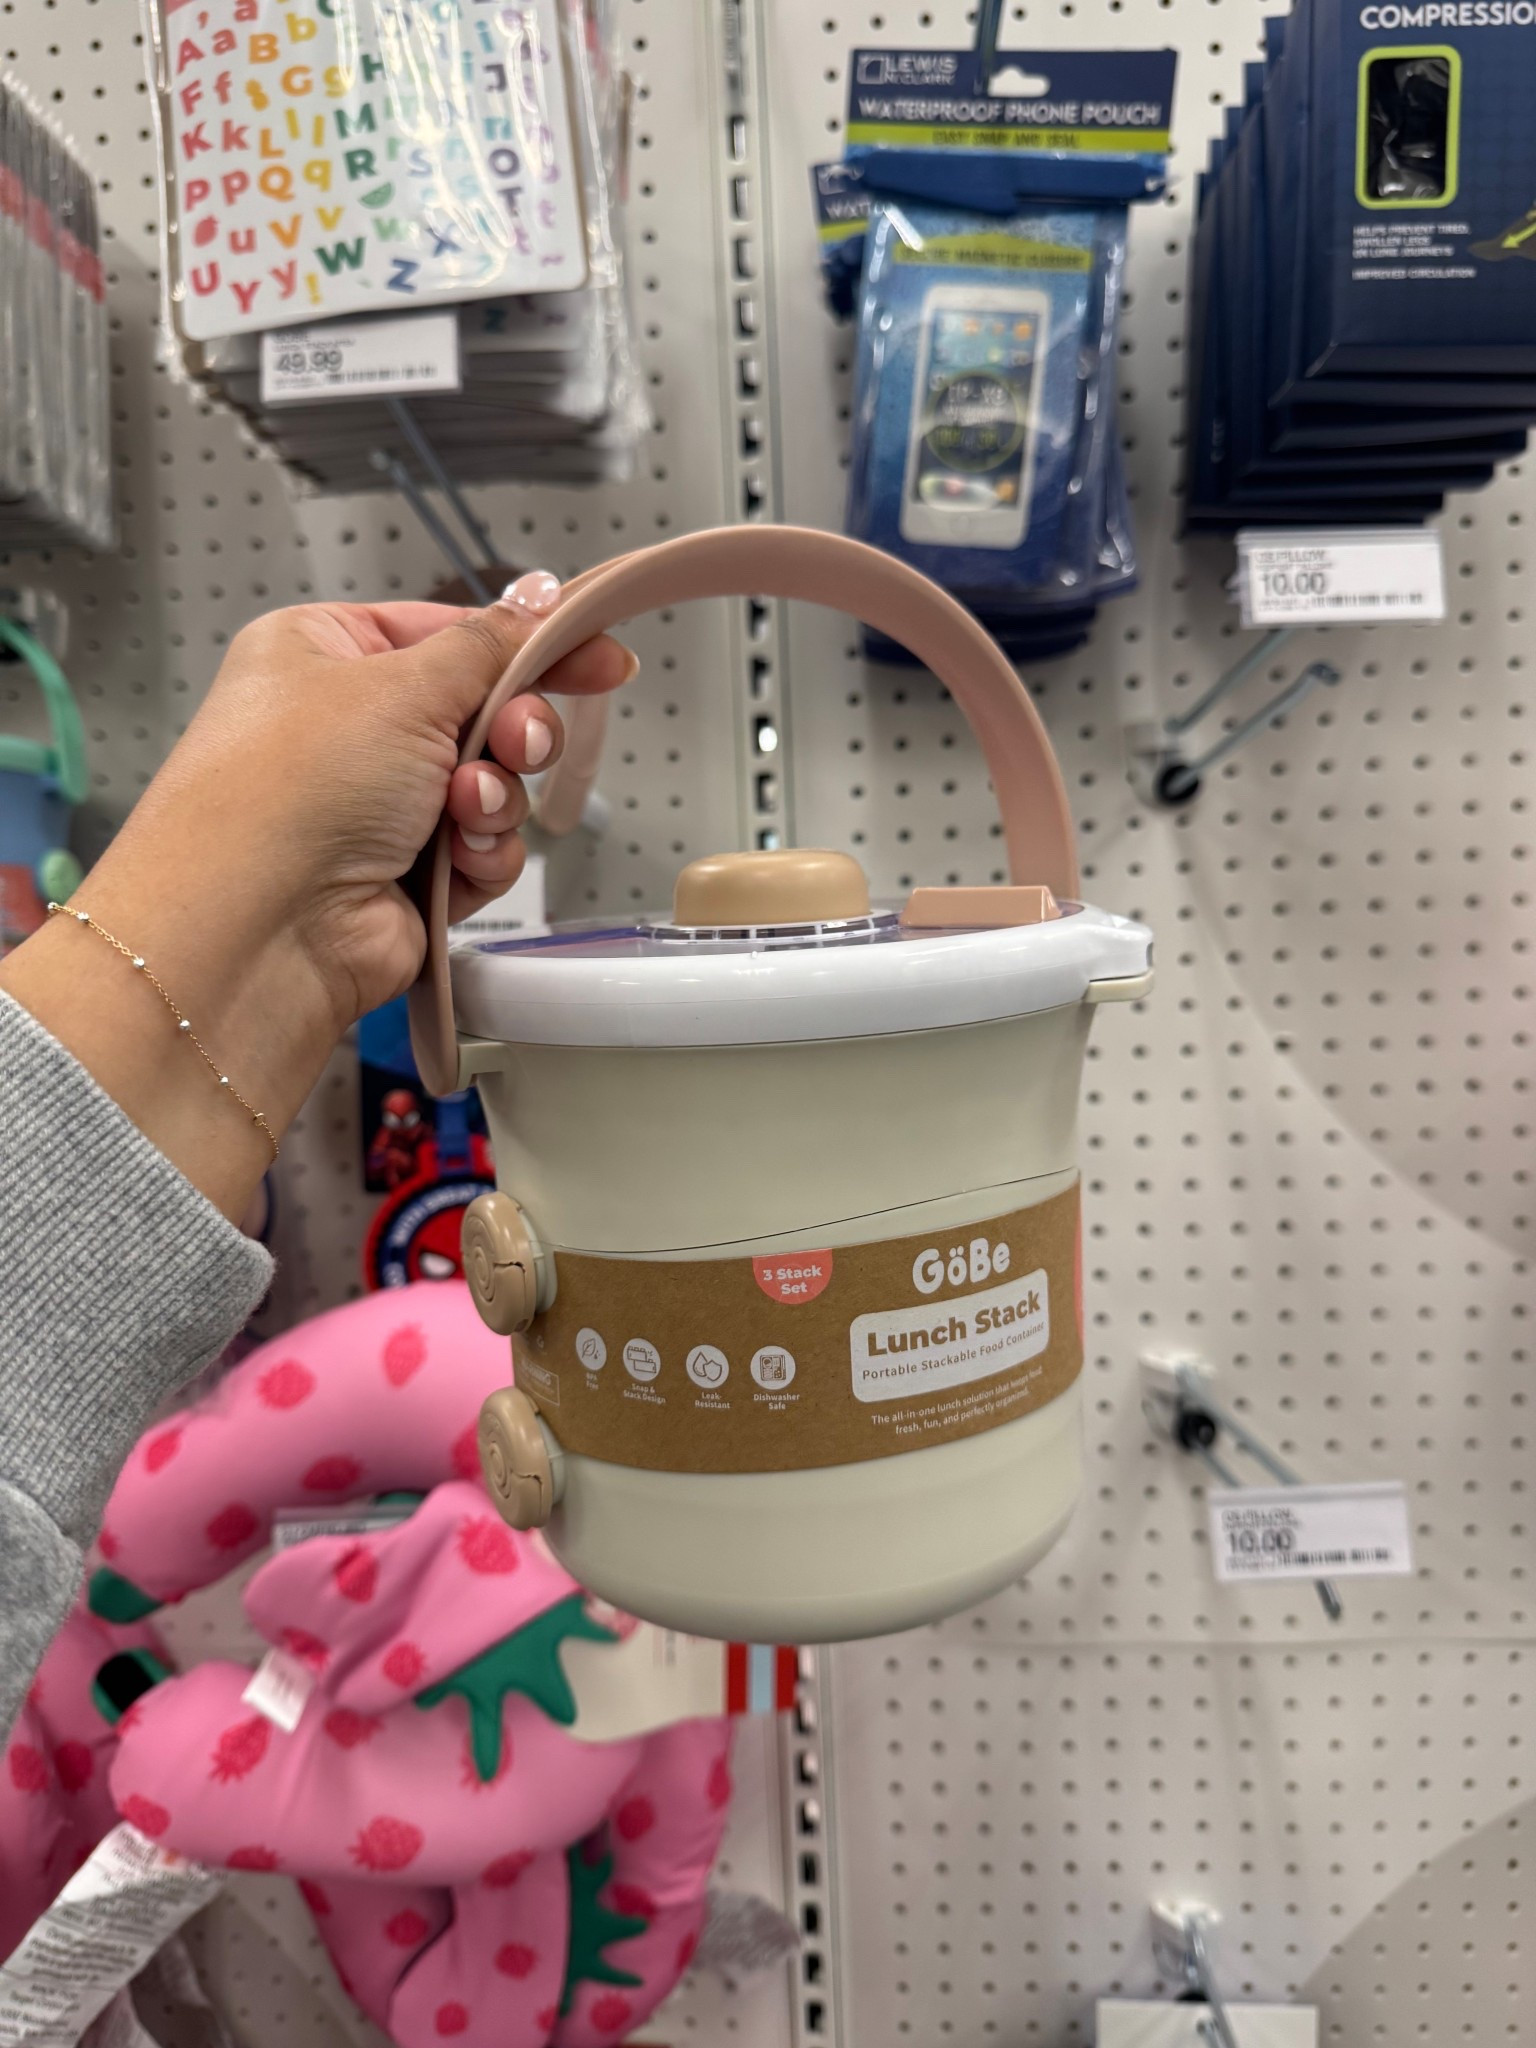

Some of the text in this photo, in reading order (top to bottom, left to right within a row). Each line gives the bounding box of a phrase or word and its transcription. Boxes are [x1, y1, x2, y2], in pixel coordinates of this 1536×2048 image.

[177, 12, 317, 74] A a B b
[885, 54, 958, 73] LEWIS
[180, 79, 203, 116] F
[214, 70, 232, 104] f
[280, 65, 313, 96] G
[858, 98, 1161, 125] WATERPROOF PHONE POUCH
[181, 121, 213, 160] K
[221, 118, 249, 151] k
[258, 127, 285, 158] L
[334, 102, 376, 139] M
[258, 165, 295, 202] Q
[303, 160, 332, 192] q
[345, 148, 377, 181] R
[229, 227, 256, 255] u
[191, 260, 220, 297] U
[230, 279, 261, 314] Y
[269, 258, 296, 300] y
[314, 237, 366, 275] W
[385, 258, 420, 294] Z
[275, 350, 343, 374] 49.99
[1261, 572, 1326, 596] 10.00
[763, 1264, 823, 1281] 3 Stack
[912, 1238, 1010, 1294] GöBe
[780, 1281, 808, 1295] Set
[867, 1290, 1040, 1356] Lunch Stack
[862, 1322, 1044, 1380] Portable Stackable Food Container
[623, 1390, 666, 1405] Stack Design
[631, 1383, 649, 1393] Snap
[701, 1392, 722, 1400] Leak-
[753, 1392, 800, 1402] Dishwasher
[694, 1400, 730, 1410] Resistant
[768, 1401, 786, 1411] Safe
[872, 1414, 890, 1425] The
[892, 1407, 936, 1421] all-in-one
[937, 1399, 961, 1413] lunch
[962, 1388, 994, 1405] solution
[995, 1382, 1009, 1394] that
[895, 1423, 921, 1434] fresh,
[923, 1417, 941, 1429] fun,
[943, 1412, 959, 1425] and
[960, 1402, 995, 1421] perfectly
[1229, 1528, 1294, 1554] 10.00
